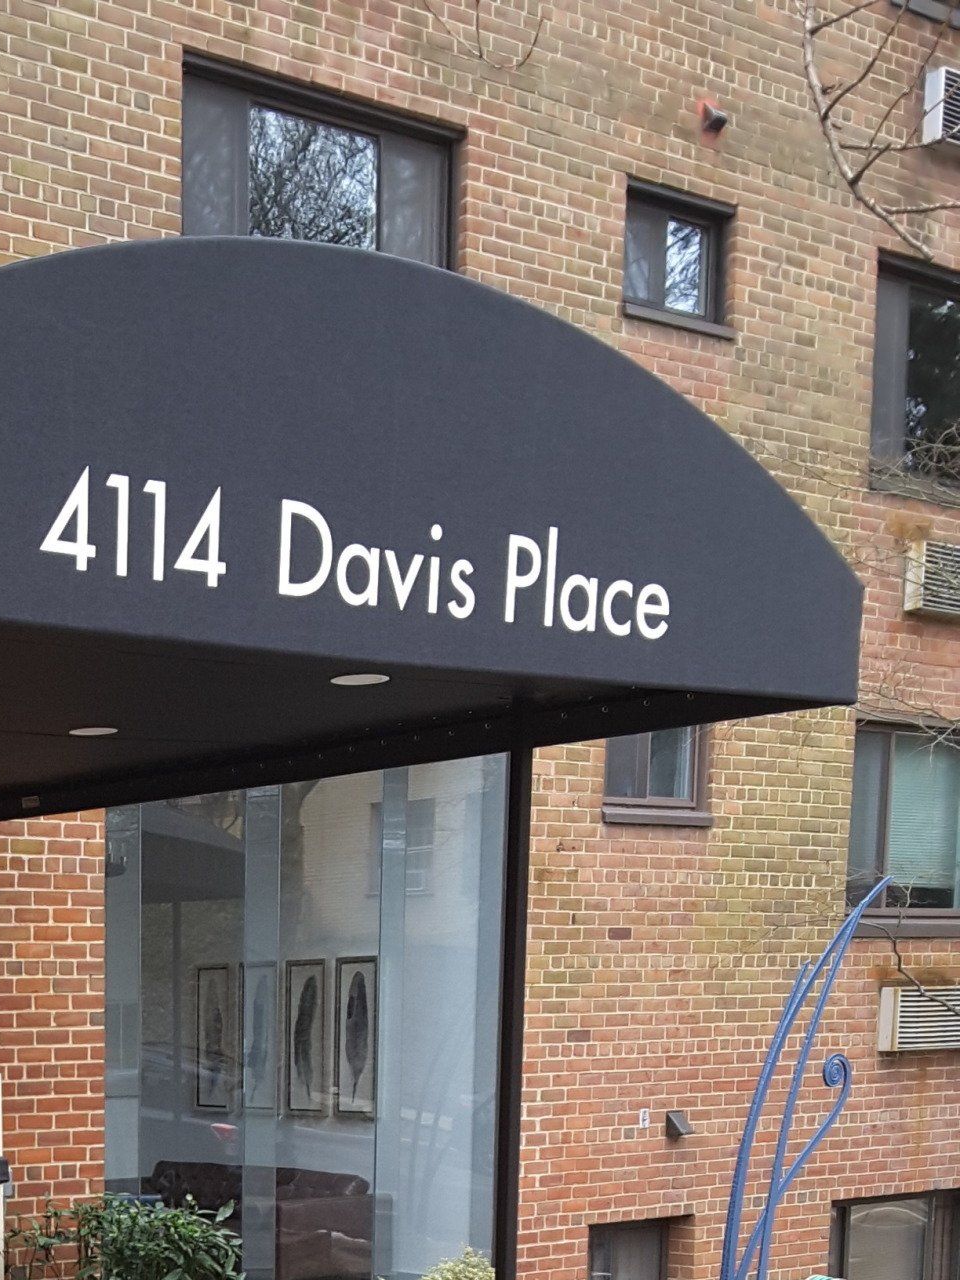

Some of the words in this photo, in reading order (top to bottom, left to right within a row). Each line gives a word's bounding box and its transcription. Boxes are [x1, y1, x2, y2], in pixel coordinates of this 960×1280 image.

[39, 465, 227, 588] 4114
[278, 498, 476, 619] Davis
[504, 526, 670, 640] Place
